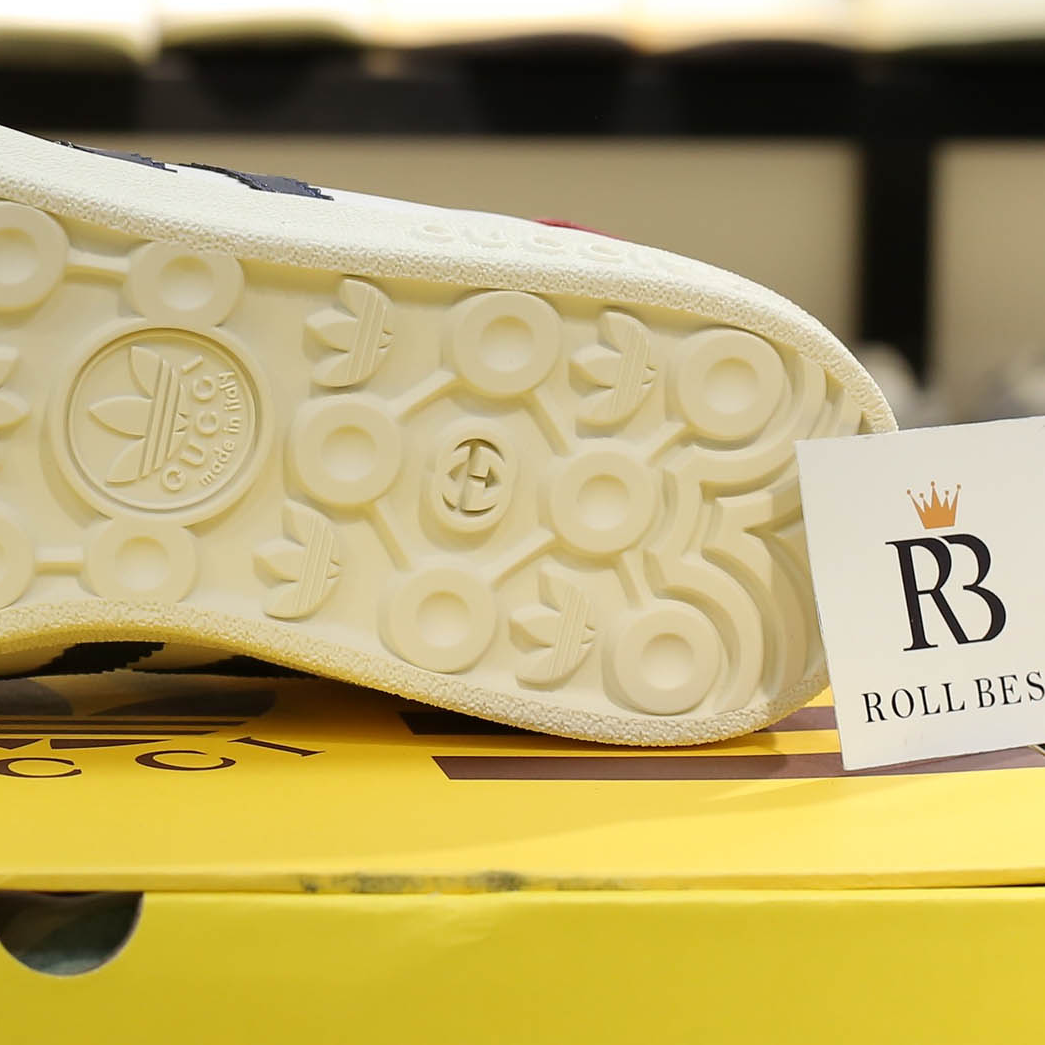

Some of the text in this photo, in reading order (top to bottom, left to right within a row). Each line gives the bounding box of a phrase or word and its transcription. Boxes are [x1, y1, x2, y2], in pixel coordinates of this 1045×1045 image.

[161, 355, 219, 492] GUCCI
[198, 439, 236, 487] made
[222, 417, 243, 435] in
[861, 670, 1045, 724] ROLL BES
